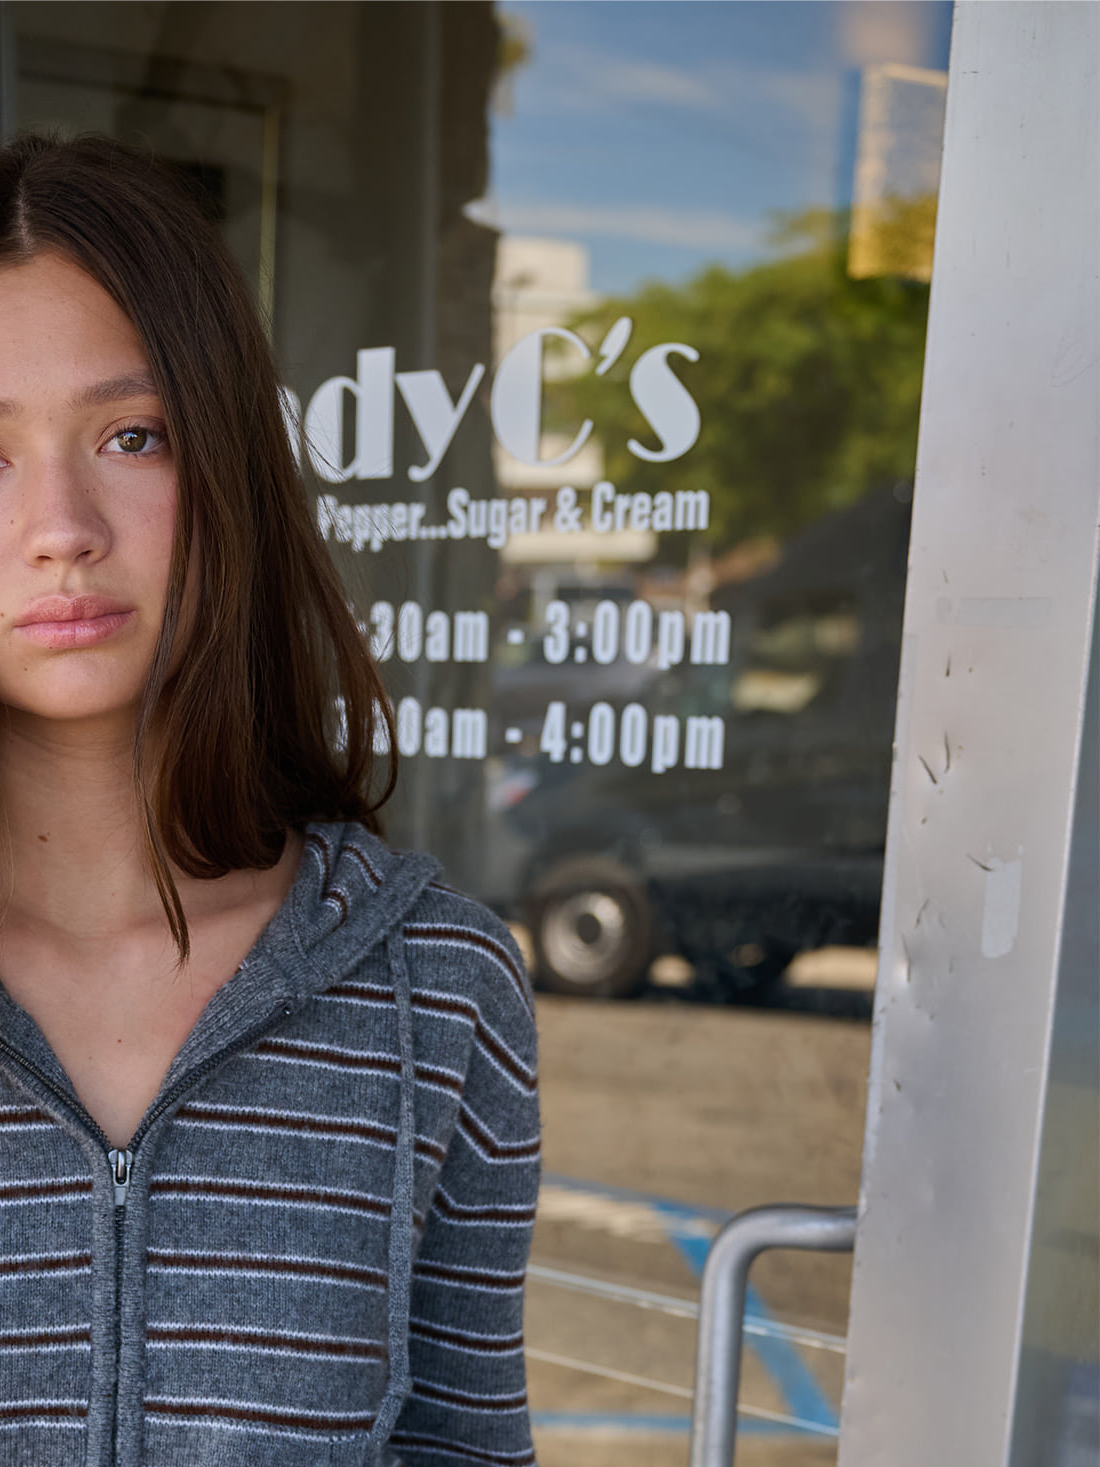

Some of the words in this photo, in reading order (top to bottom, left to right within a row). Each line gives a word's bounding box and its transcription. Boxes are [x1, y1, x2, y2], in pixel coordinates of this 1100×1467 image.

[554, 486, 583, 532] &
[591, 481, 710, 532] Cream
[543, 600, 731, 671] 3:00pm
[540, 701, 725, 774] 4:00pm
